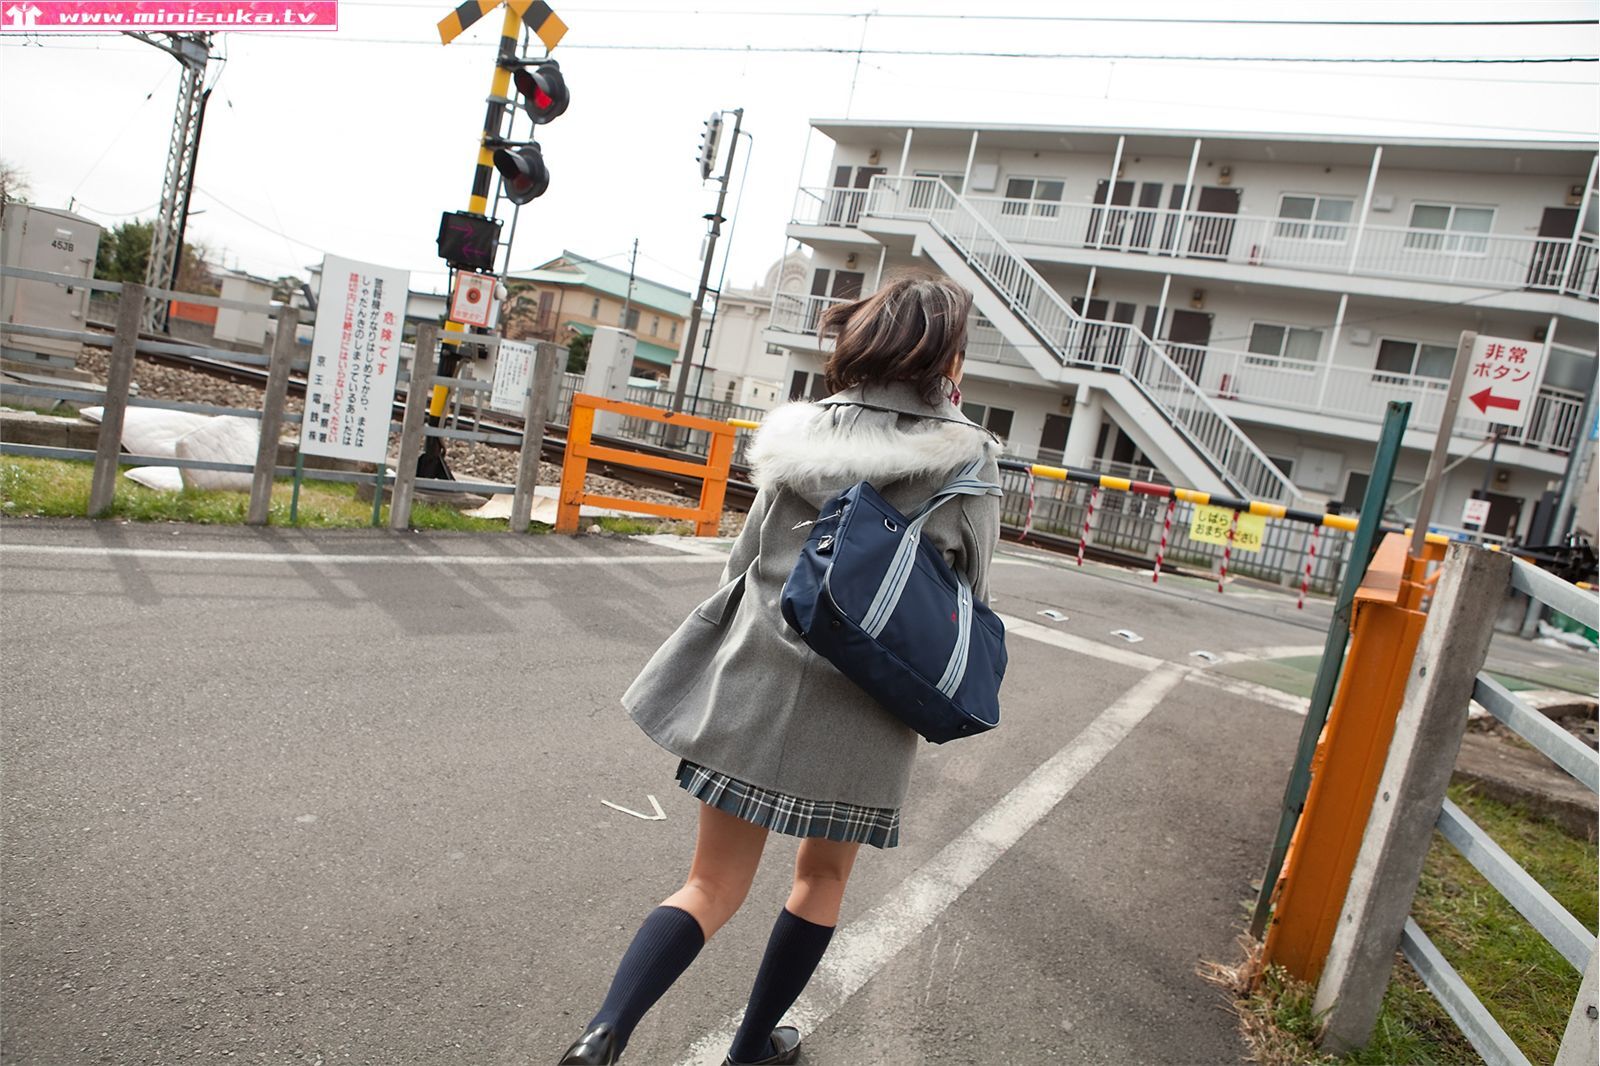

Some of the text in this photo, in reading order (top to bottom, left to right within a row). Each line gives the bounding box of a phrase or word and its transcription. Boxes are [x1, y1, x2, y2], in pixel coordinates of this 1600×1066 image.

[51, 240, 74, 252] 45JB
[377, 311, 394, 375] 危険です
[1485, 343, 1528, 363] 非常
[1473, 362, 1530, 382] ボタン
[1199, 511, 1236, 526] しばら
